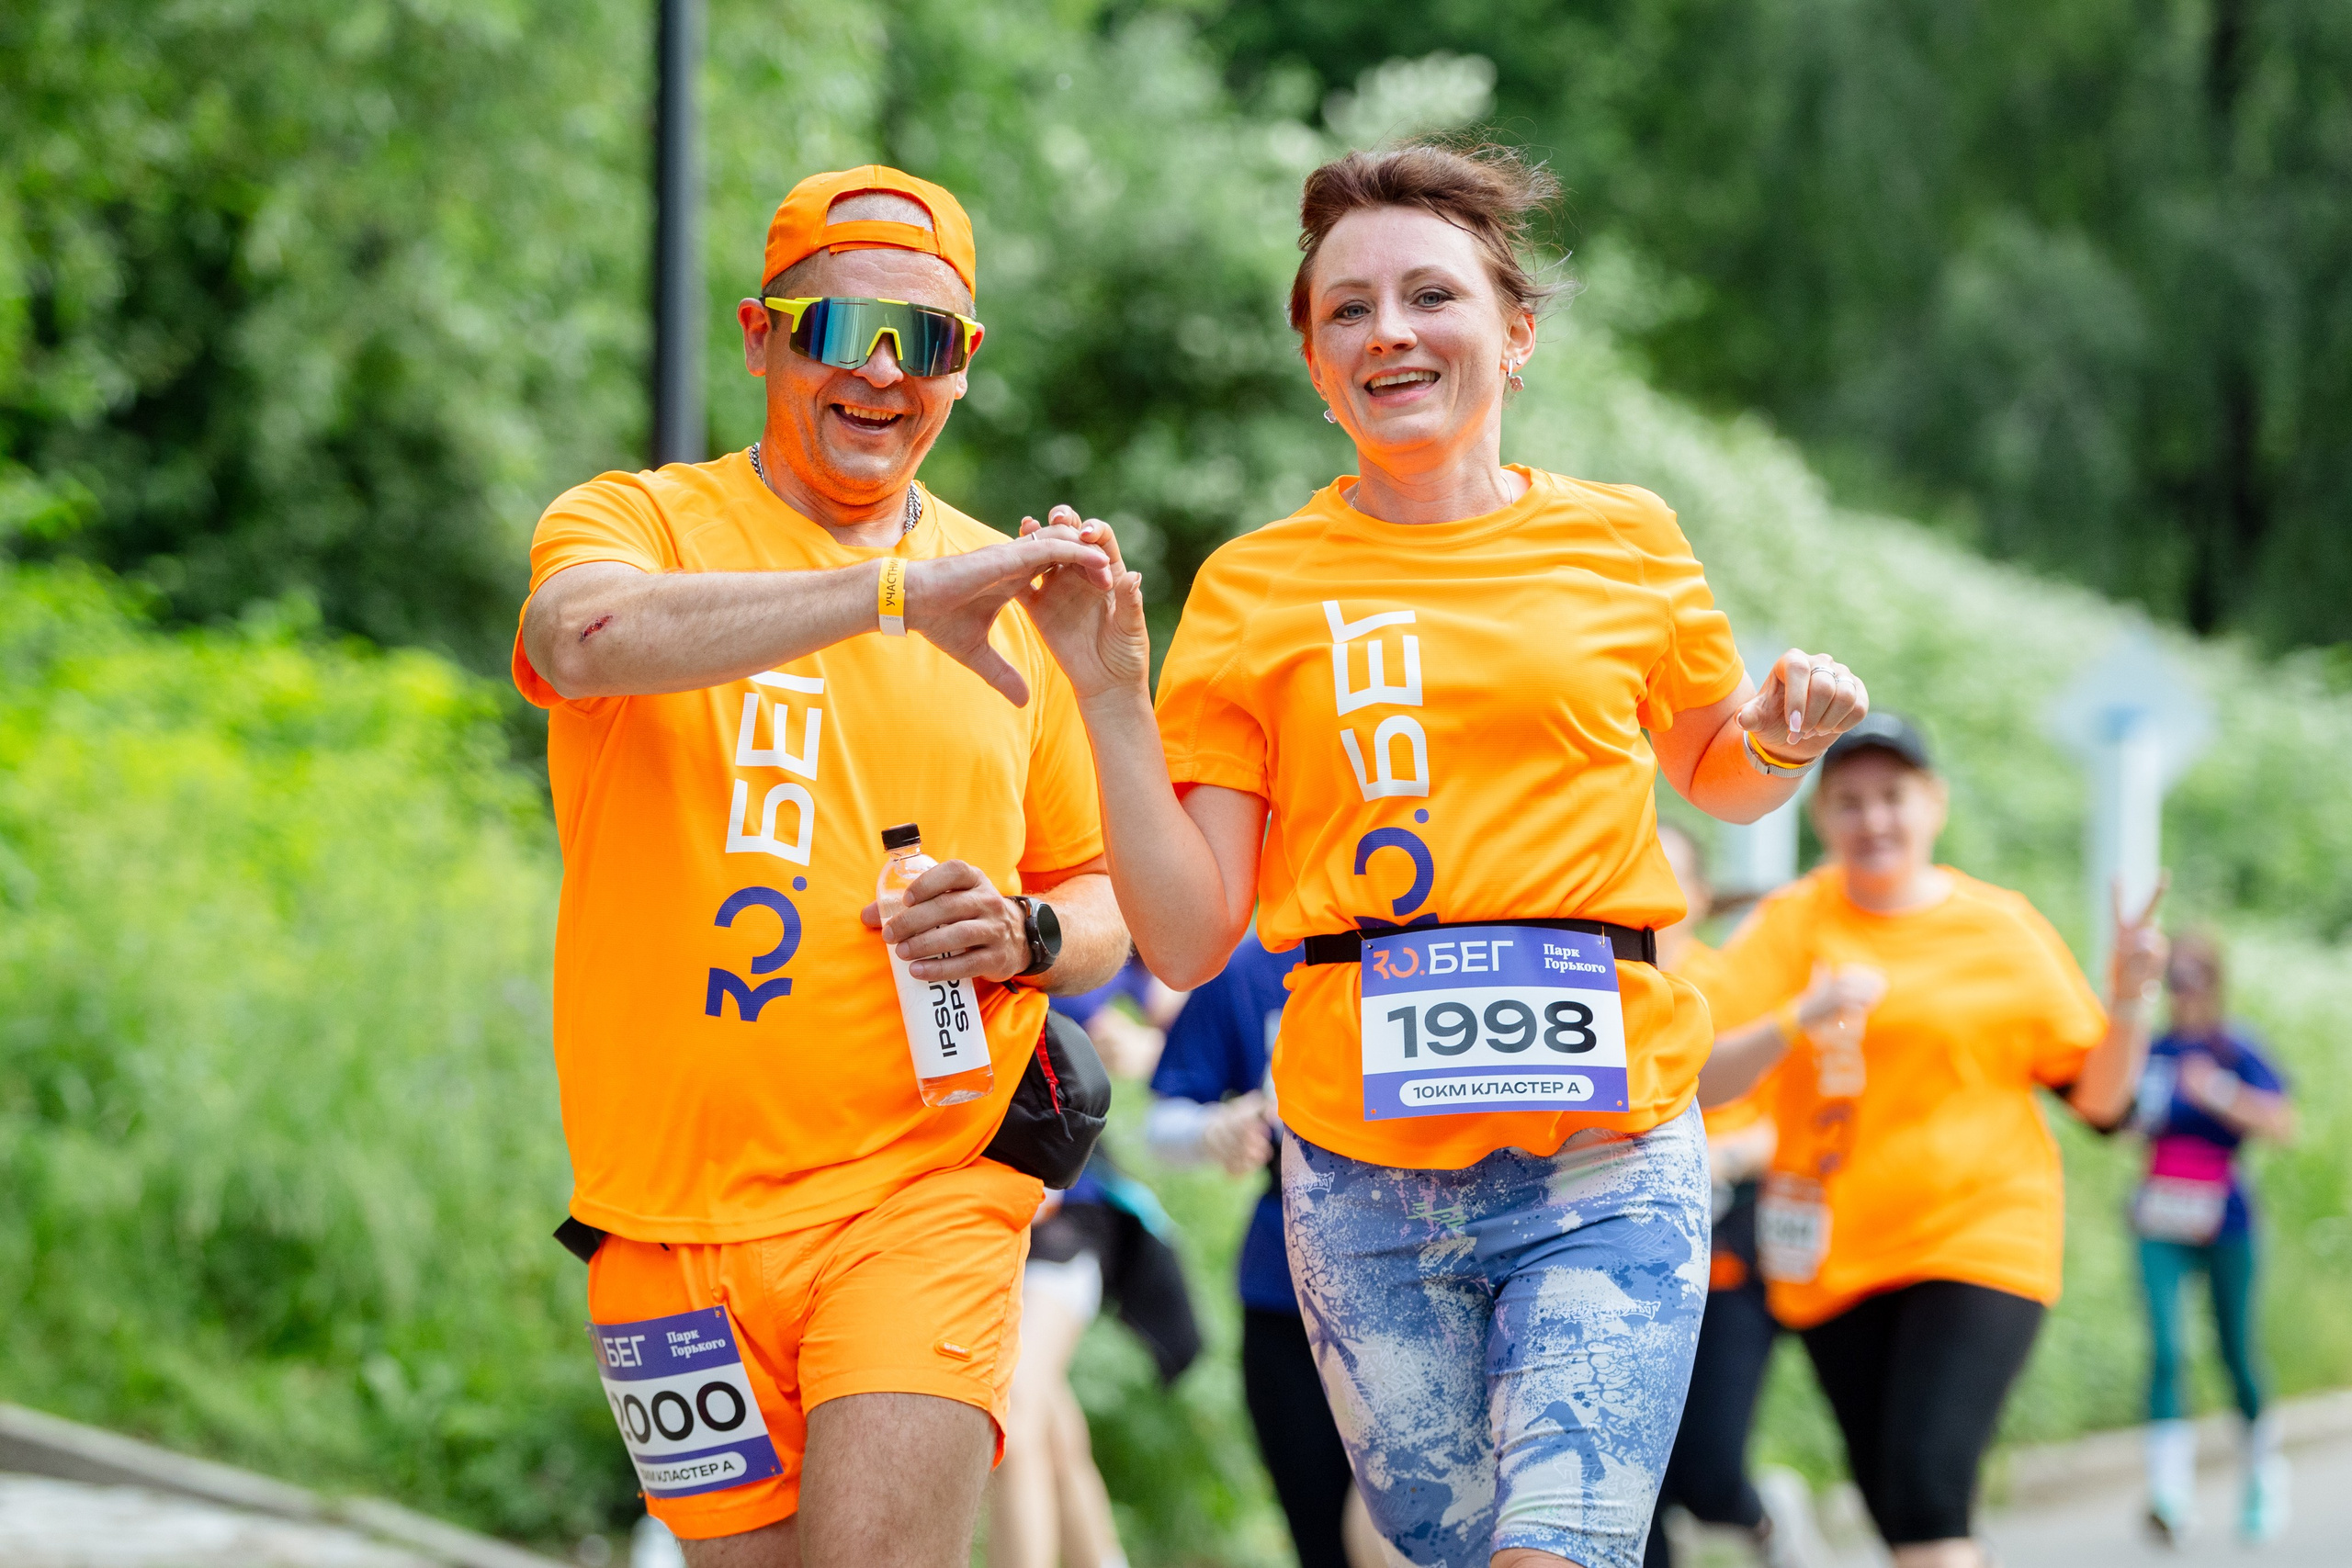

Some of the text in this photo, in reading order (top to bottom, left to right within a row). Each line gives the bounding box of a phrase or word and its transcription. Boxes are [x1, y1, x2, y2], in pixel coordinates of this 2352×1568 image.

[886, 558, 899, 606] УЧАСТНИ
[1544, 943, 1580, 960] Парк
[1544, 957, 1606, 974] Горького
[928, 980, 957, 1057] IPSU
[1387, 999, 1597, 1058] 1998
[1413, 1081, 1580, 1099] 10КМ КЛАСТЕР А
[666, 1329, 700, 1345] Парк
[670, 1338, 726, 1359] Горького
[657, 1462, 718, 1483] КЛАСТЕР
[723, 1460, 735, 1472] А
